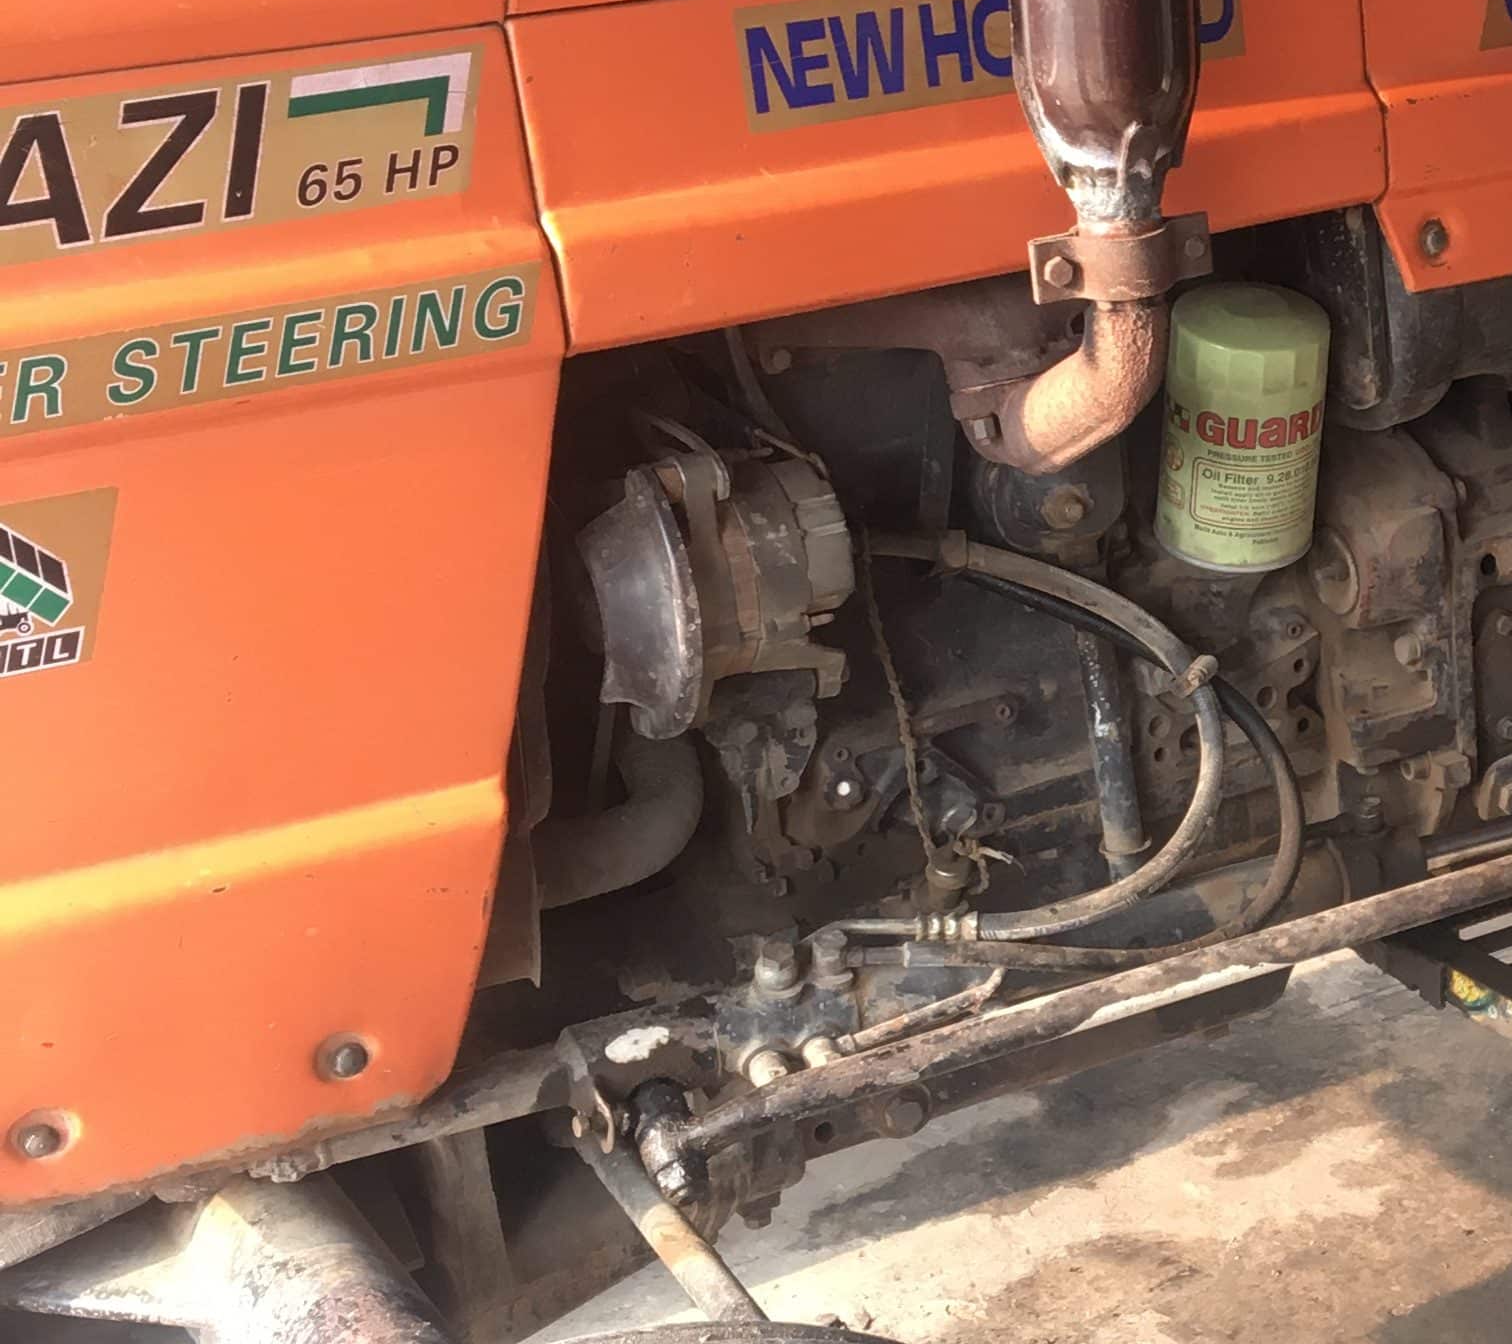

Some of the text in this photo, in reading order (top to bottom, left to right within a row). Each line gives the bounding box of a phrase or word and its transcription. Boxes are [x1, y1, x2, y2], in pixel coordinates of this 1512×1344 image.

[745, 6, 905, 114] NEW
[297, 142, 461, 208] 65 HP
[0, 274, 526, 424] R STEERING
[1201, 467, 1221, 482] Oil
[1224, 472, 1260, 485] Filter
[0, 635, 73, 670] TL
